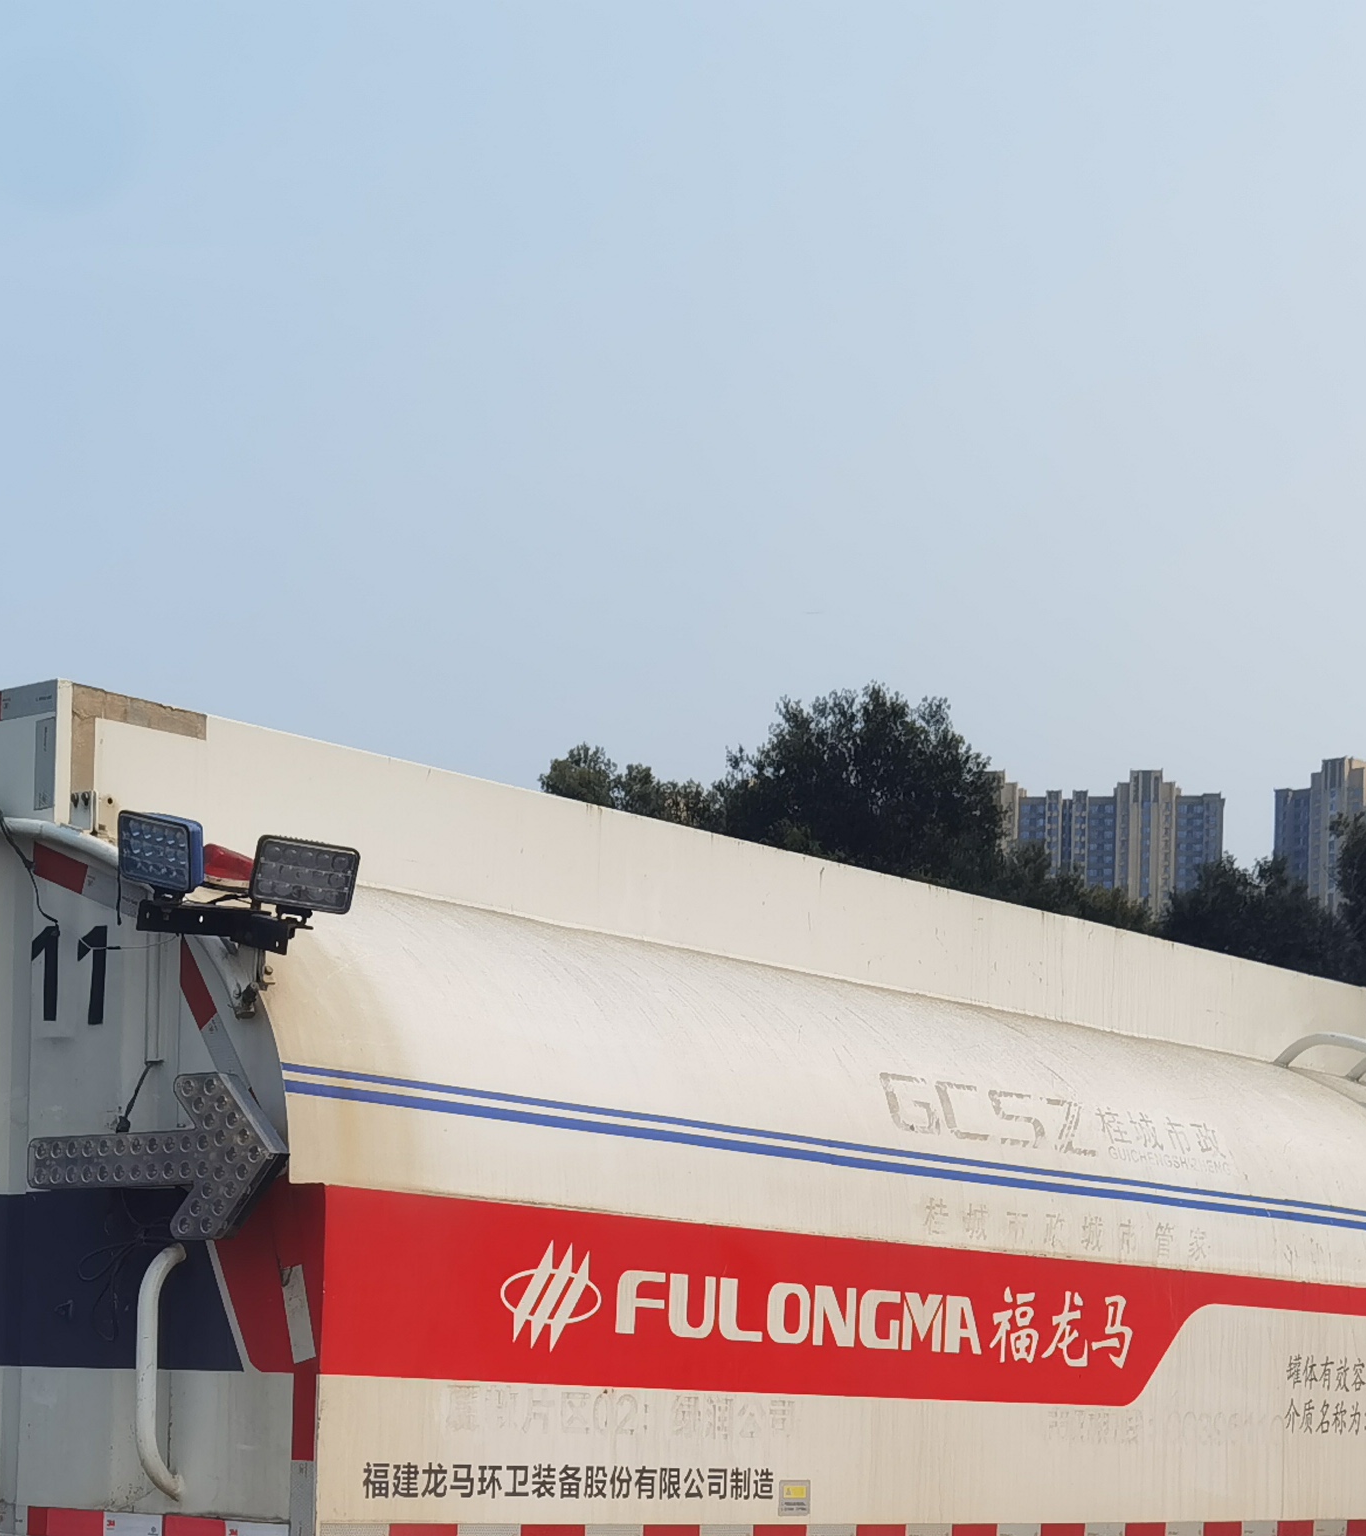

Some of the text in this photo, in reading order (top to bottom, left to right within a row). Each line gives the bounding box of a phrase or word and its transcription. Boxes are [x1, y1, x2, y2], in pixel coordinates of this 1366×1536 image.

[615, 1269, 1134, 1369] FULONGMA 福龙马
[362, 1461, 774, 1501] 福建龙马环卫装备股份有限公司制造
